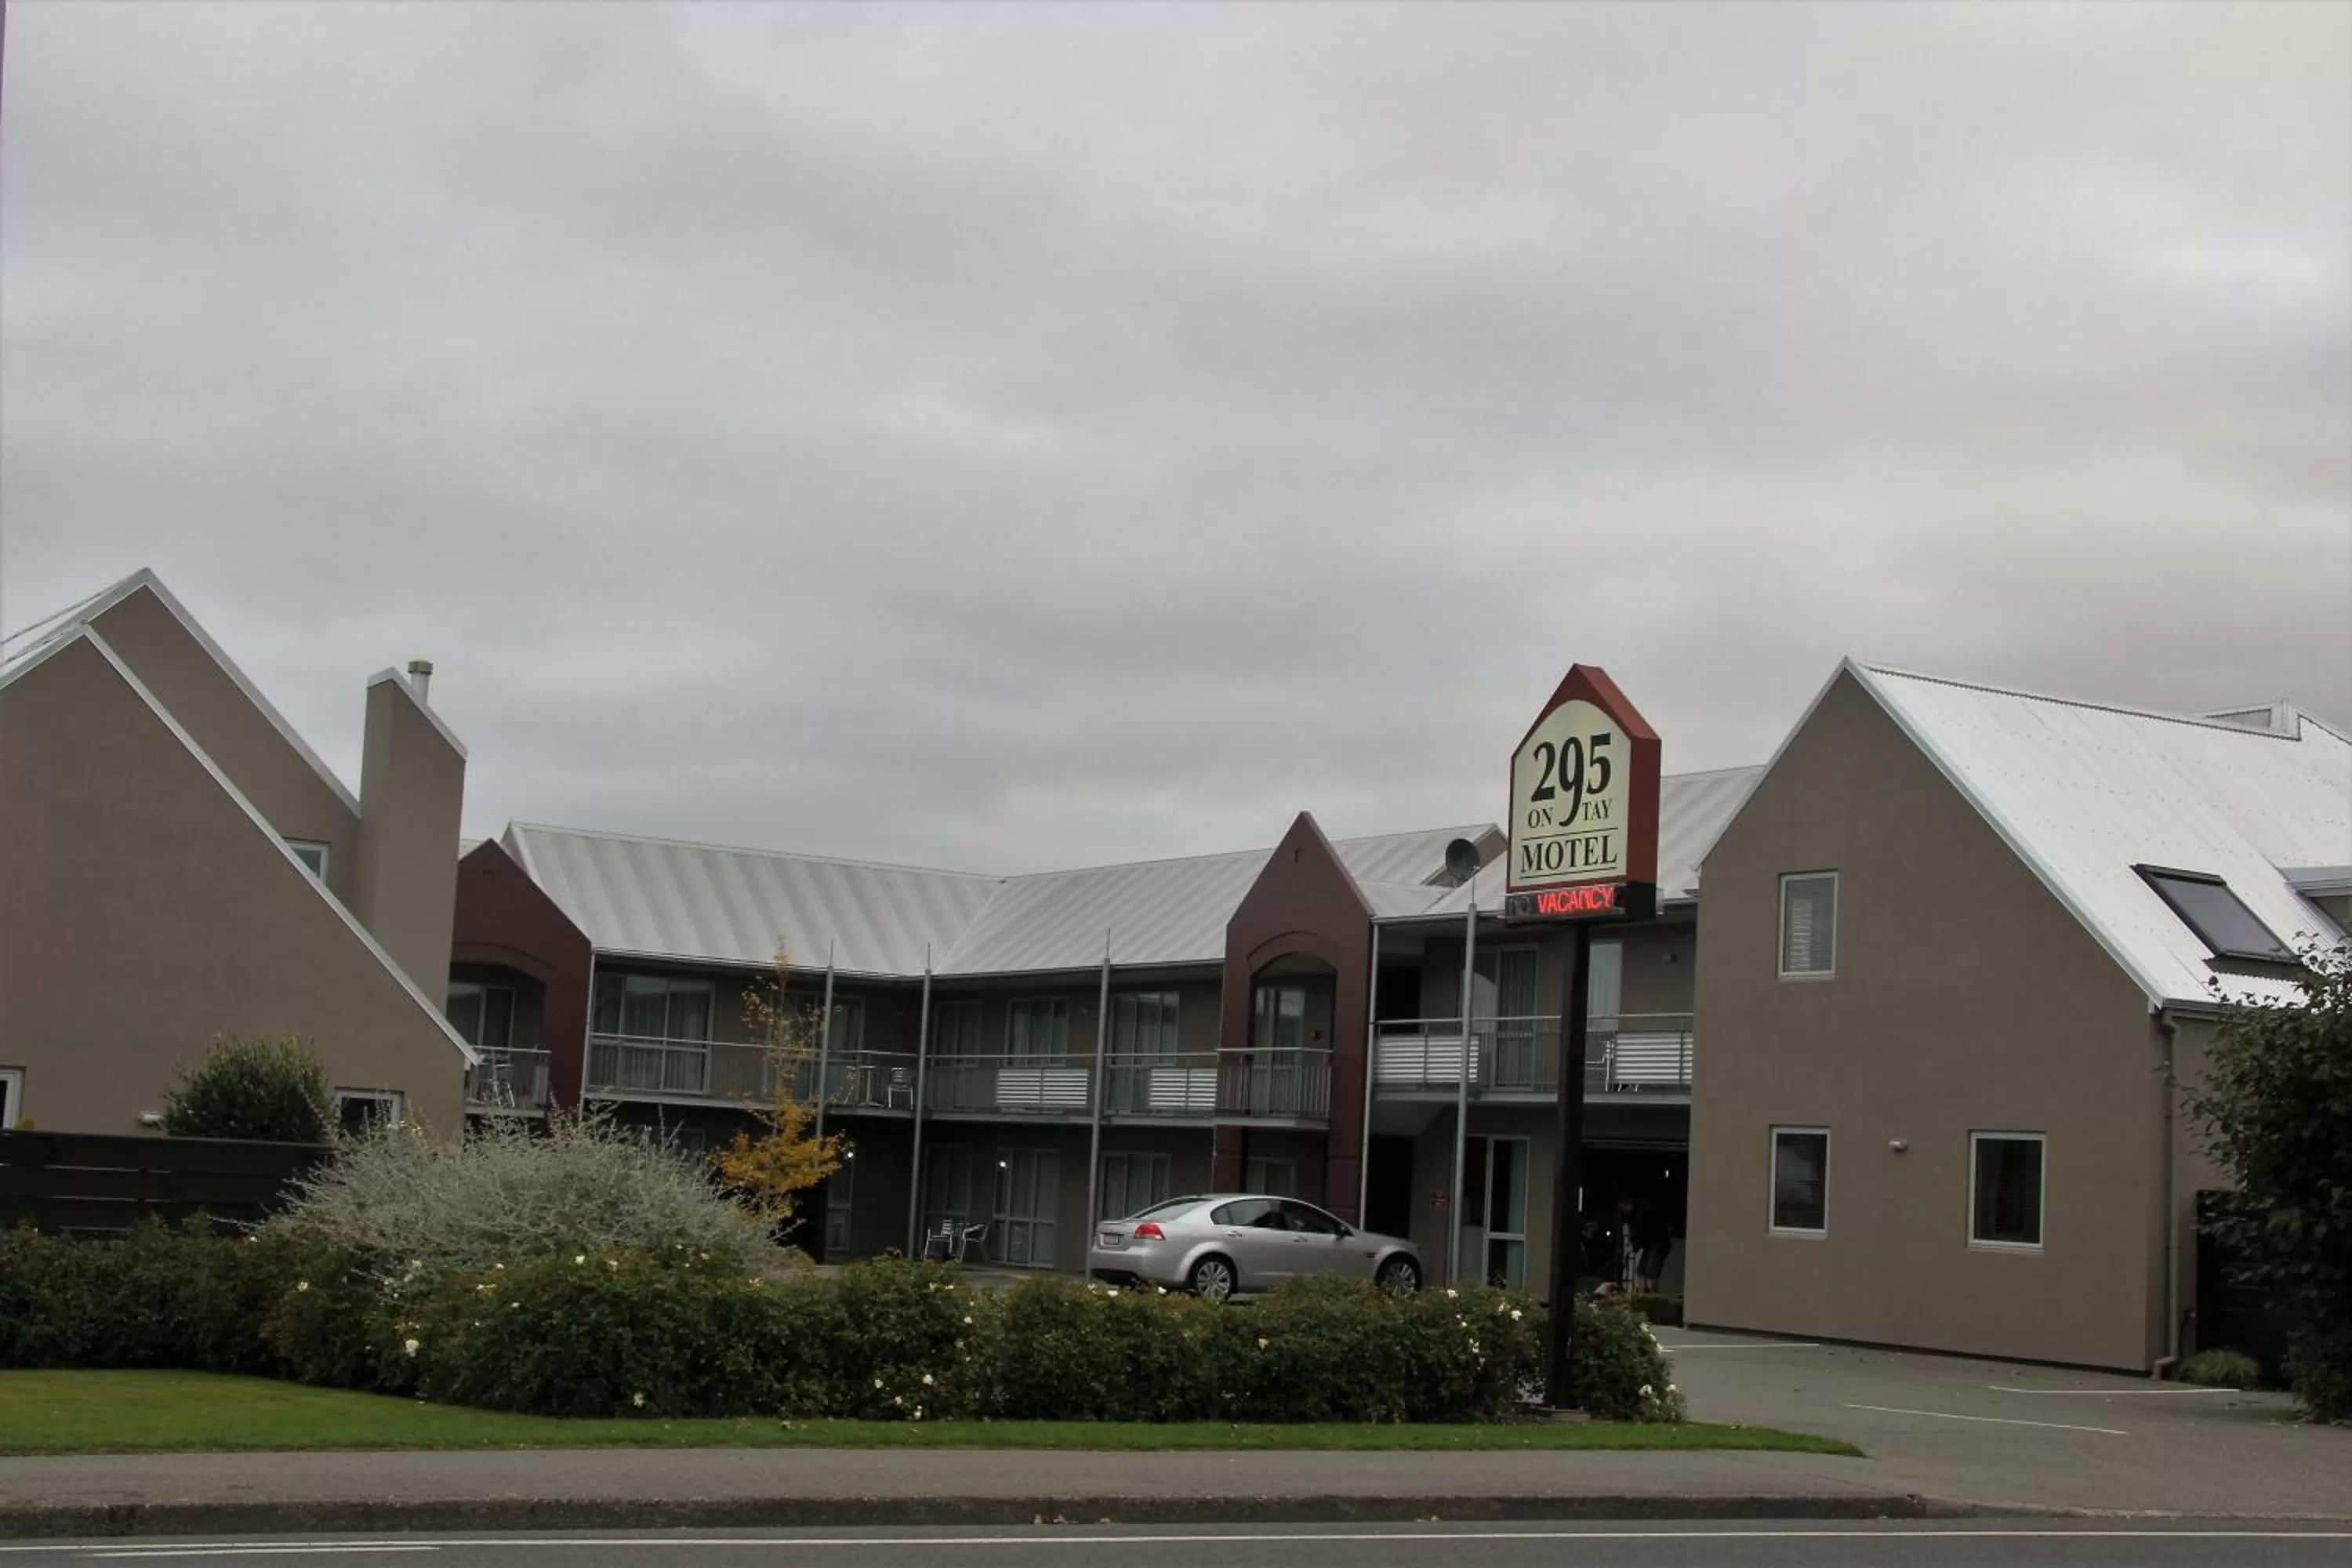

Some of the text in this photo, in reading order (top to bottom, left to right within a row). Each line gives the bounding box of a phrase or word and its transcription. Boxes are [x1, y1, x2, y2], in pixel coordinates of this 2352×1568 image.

[1531, 732, 1611, 826] 295
[1528, 799, 1613, 829] ON TAY
[1521, 836, 1617, 873] MOTEL
[1537, 886, 1614, 913] VACANCY
